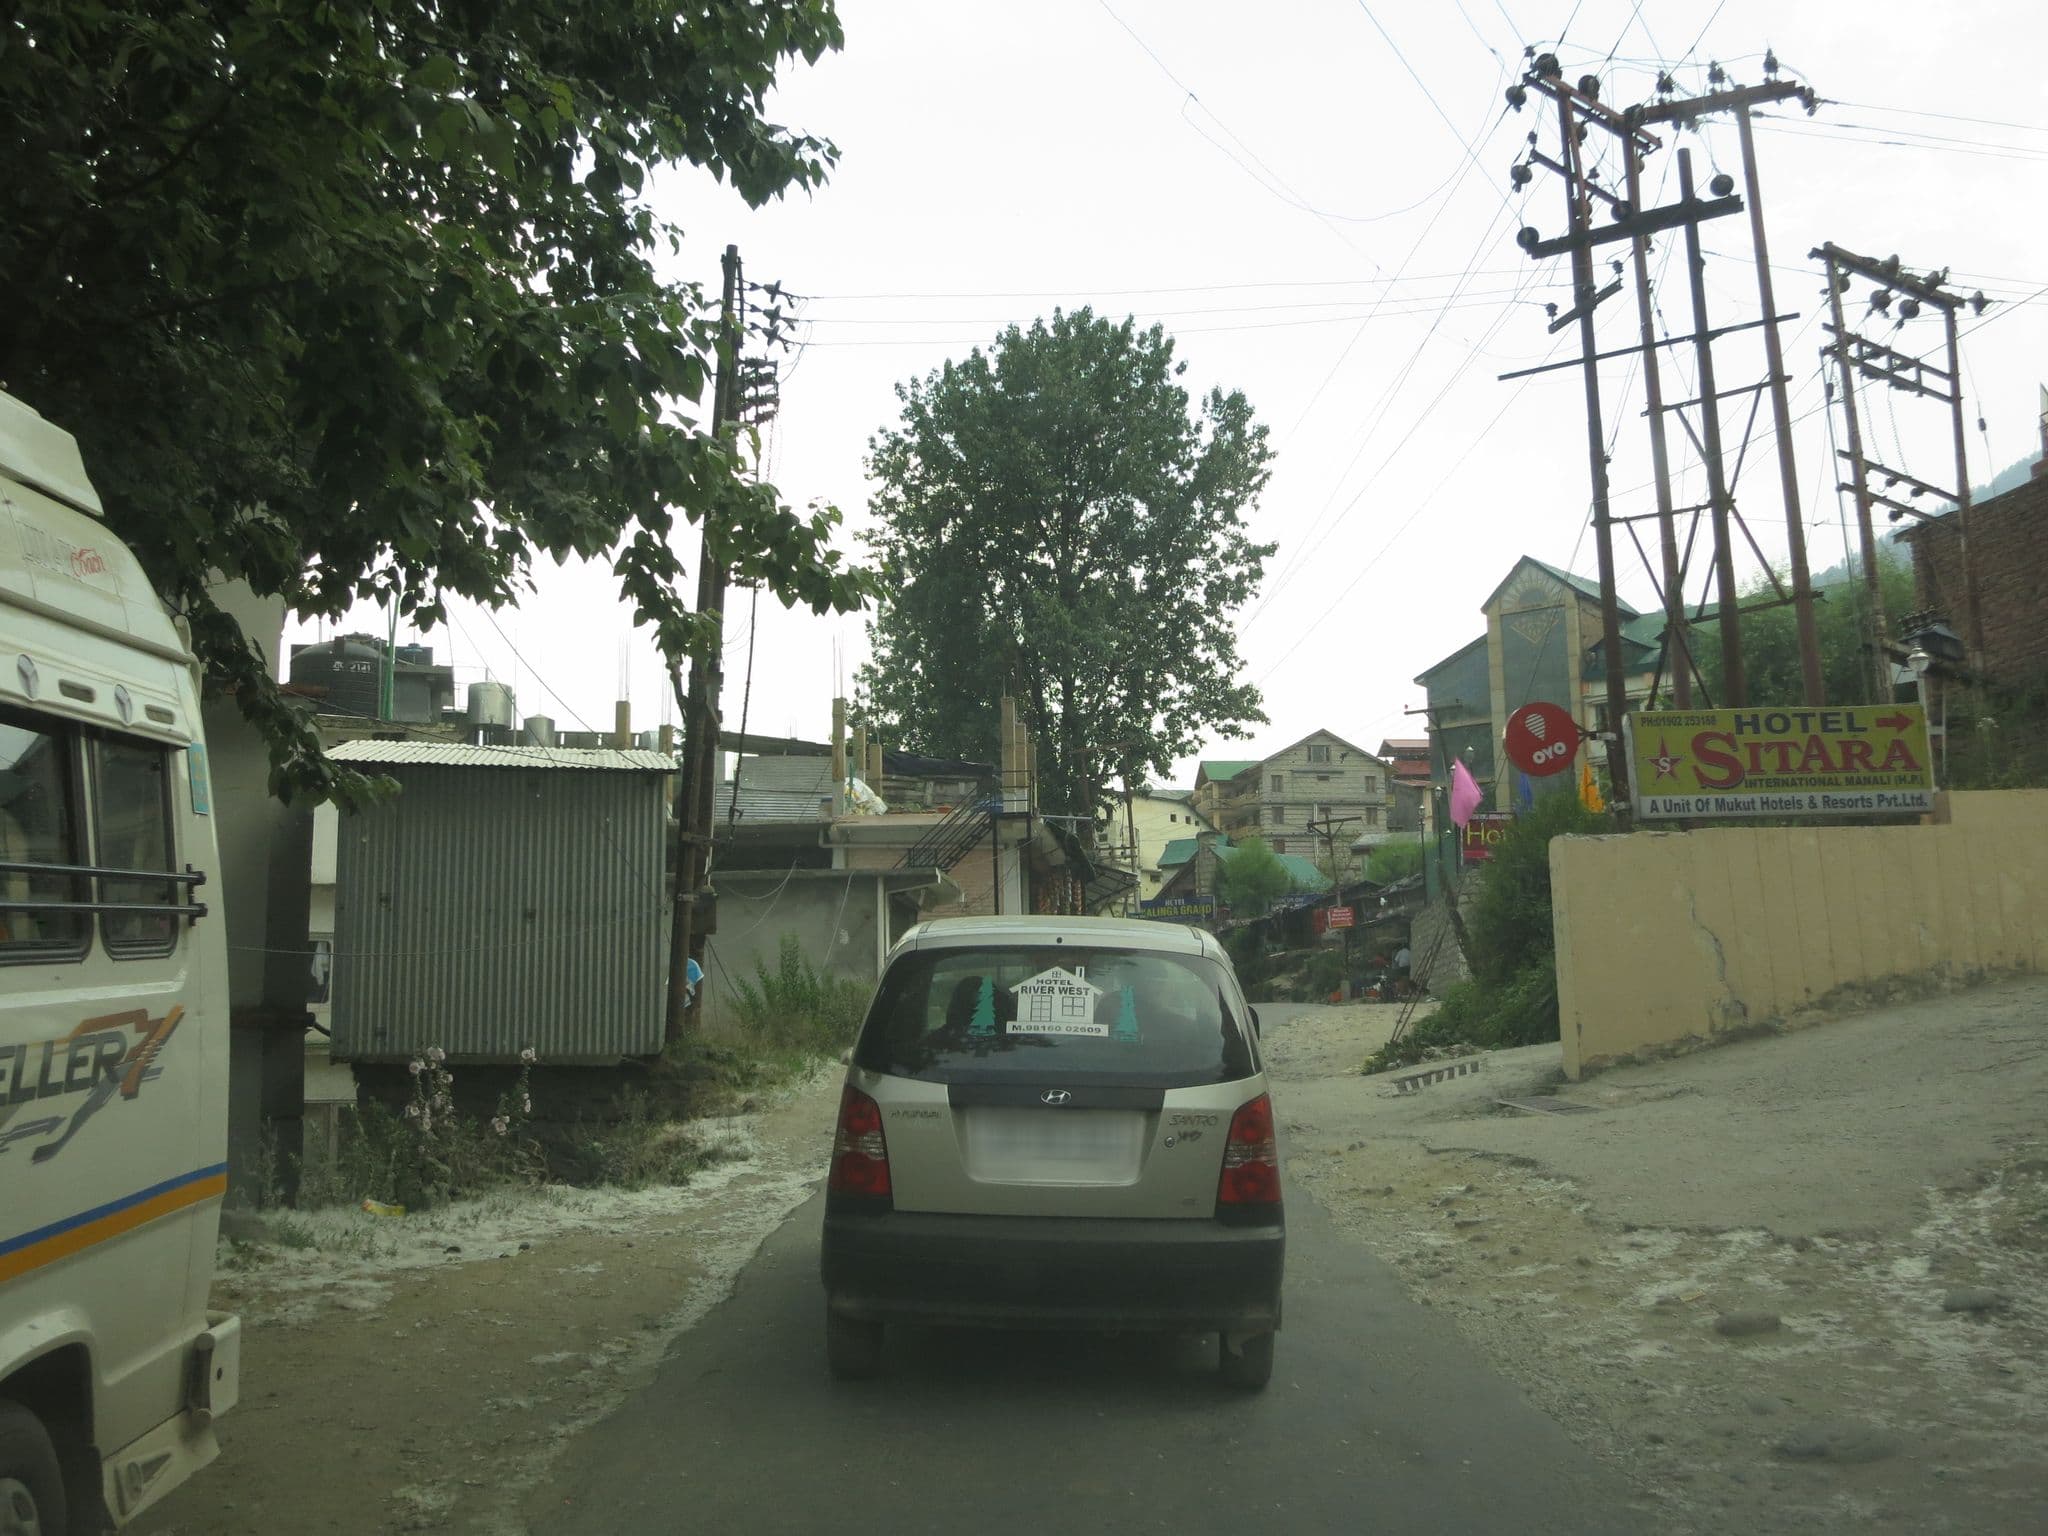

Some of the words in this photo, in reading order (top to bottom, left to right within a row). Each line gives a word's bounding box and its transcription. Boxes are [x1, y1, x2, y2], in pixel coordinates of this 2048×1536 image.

[1734, 711, 1868, 735] HOTEL
[1532, 742, 1567, 764] OYO
[1691, 731, 1922, 789] SITARA
[1659, 757, 1671, 772] S
[1744, 777, 1841, 789] INTERNATIONAL
[1845, 776, 1891, 786] MANALI
[1650, 800, 1659, 813] A
[1662, 799, 1692, 814] Unit
[1695, 798, 1713, 812] Of
[1715, 797, 1758, 812] Mukut
[1760, 796, 1804, 811] Hotels
[1805, 795, 1818, 809] &
[1822, 794, 1873, 809] Resorts
[1020, 986, 1055, 995] RIVER
[1058, 987, 1090, 996] WEST
